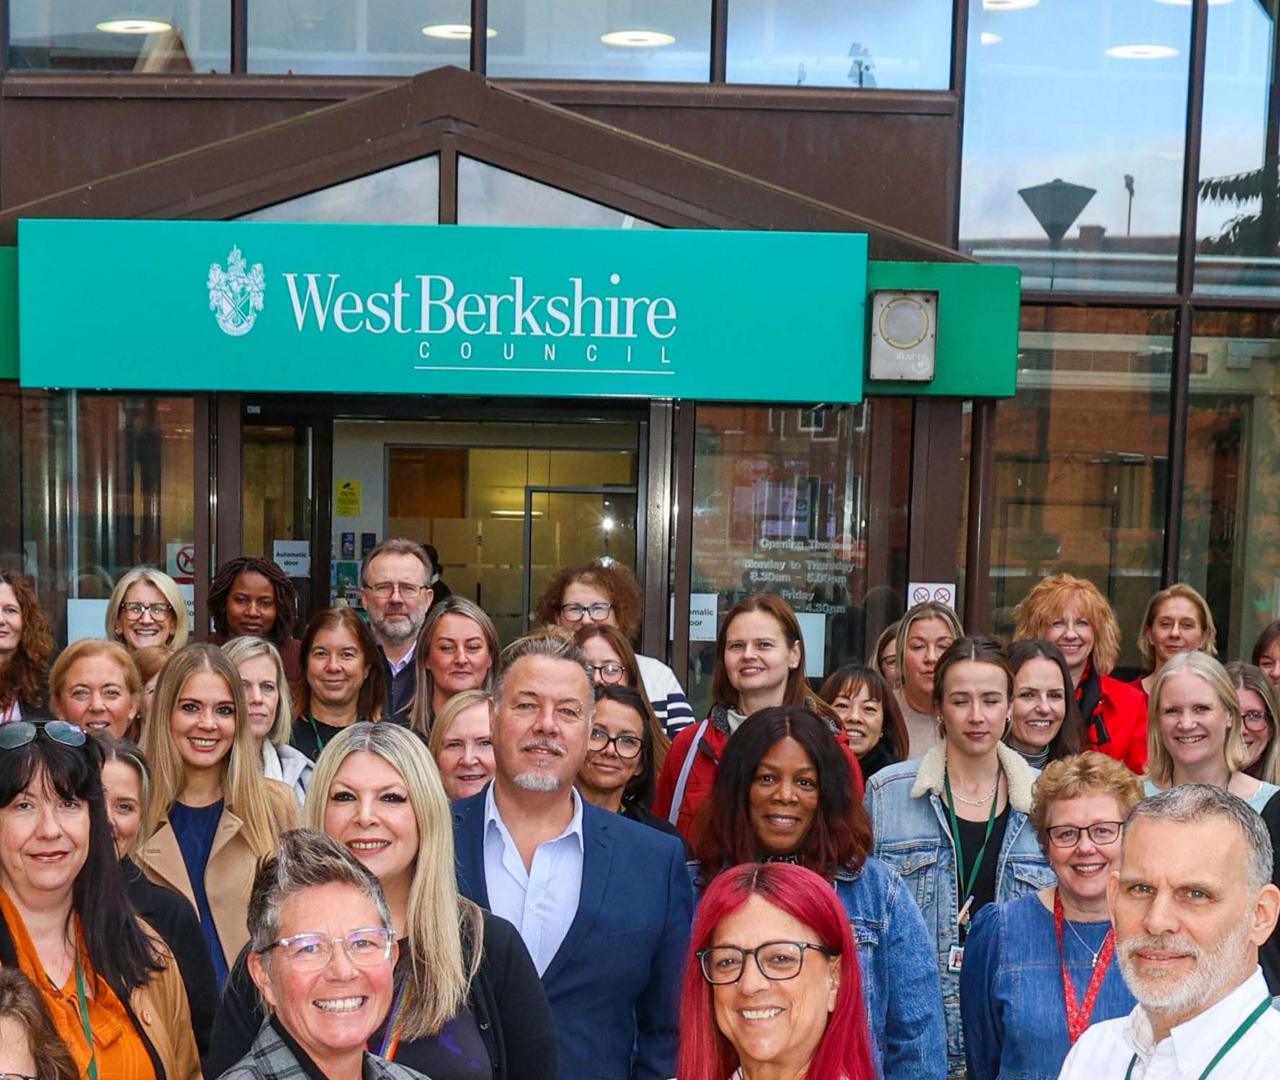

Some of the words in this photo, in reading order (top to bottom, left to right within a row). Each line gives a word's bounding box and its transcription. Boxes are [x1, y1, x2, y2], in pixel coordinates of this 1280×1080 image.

[419, 341, 671, 364] COUNCIL
[760, 539, 805, 551] Opening
[743, 559, 786, 570] Monday
[806, 560, 855, 573] Thursday
[781, 588, 815, 601] Friday
[689, 608, 715, 616] matic
